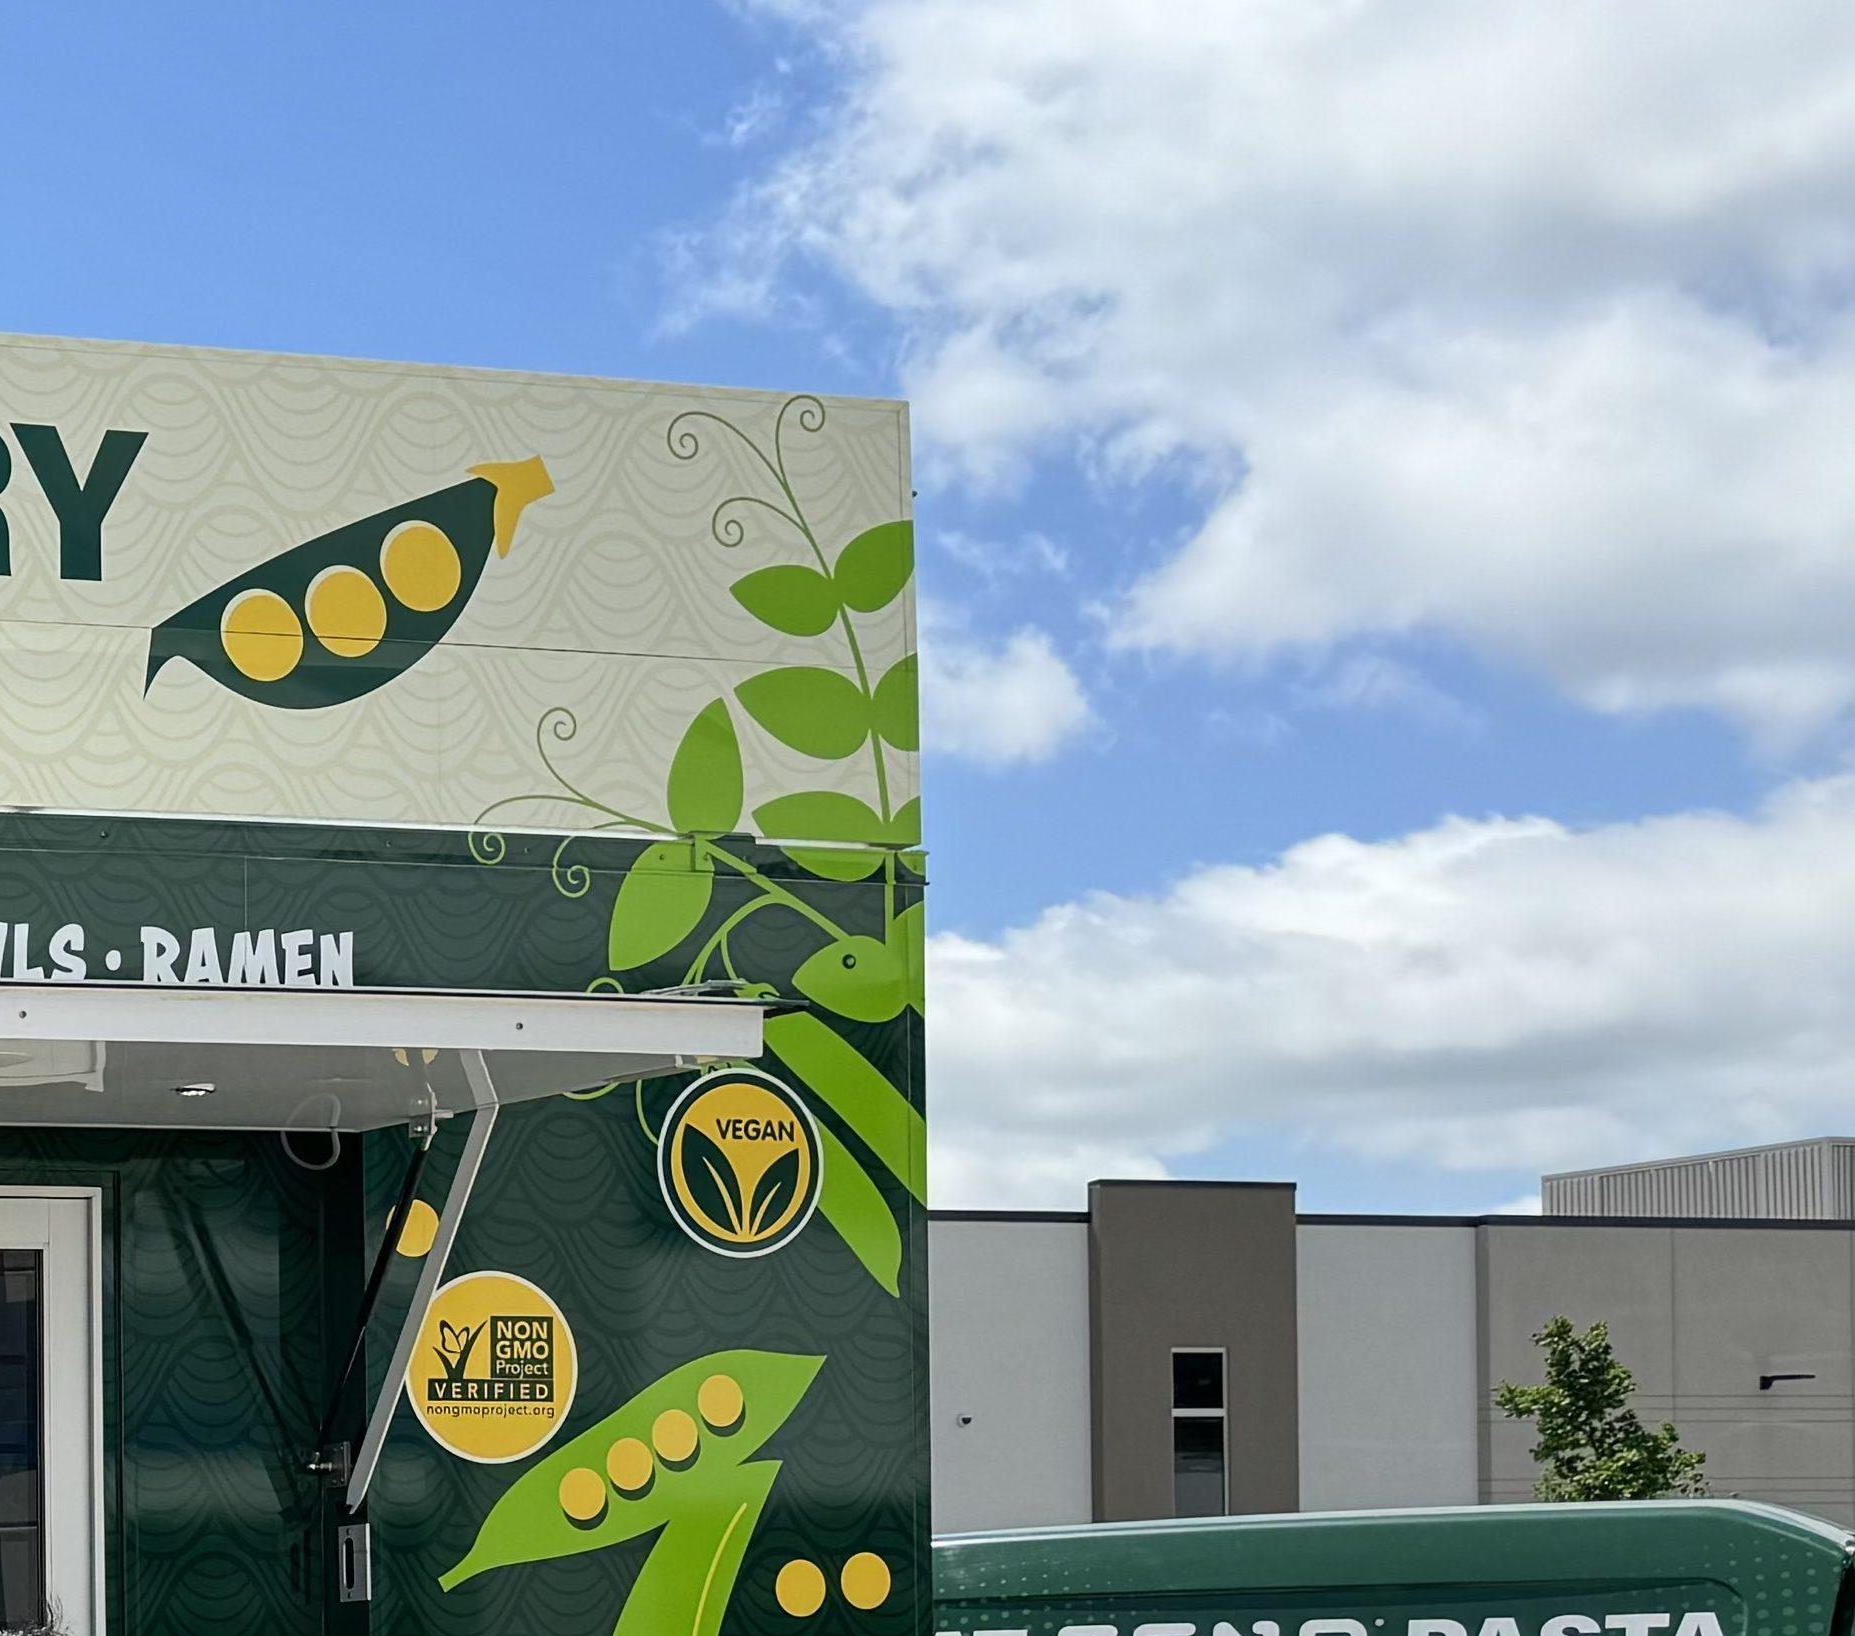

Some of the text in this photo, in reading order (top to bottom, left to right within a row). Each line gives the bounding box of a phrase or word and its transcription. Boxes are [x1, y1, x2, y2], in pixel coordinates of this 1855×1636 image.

[140, 926, 354, 987] RAMEN
[716, 1118, 796, 1142] VEGAN
[496, 1320, 548, 1340] NON
[495, 1340, 549, 1360] GMO
[496, 1360, 549, 1379] Project
[434, 1382, 549, 1399] VERIFIED
[427, 1404, 555, 1418] nongmoproject.org
